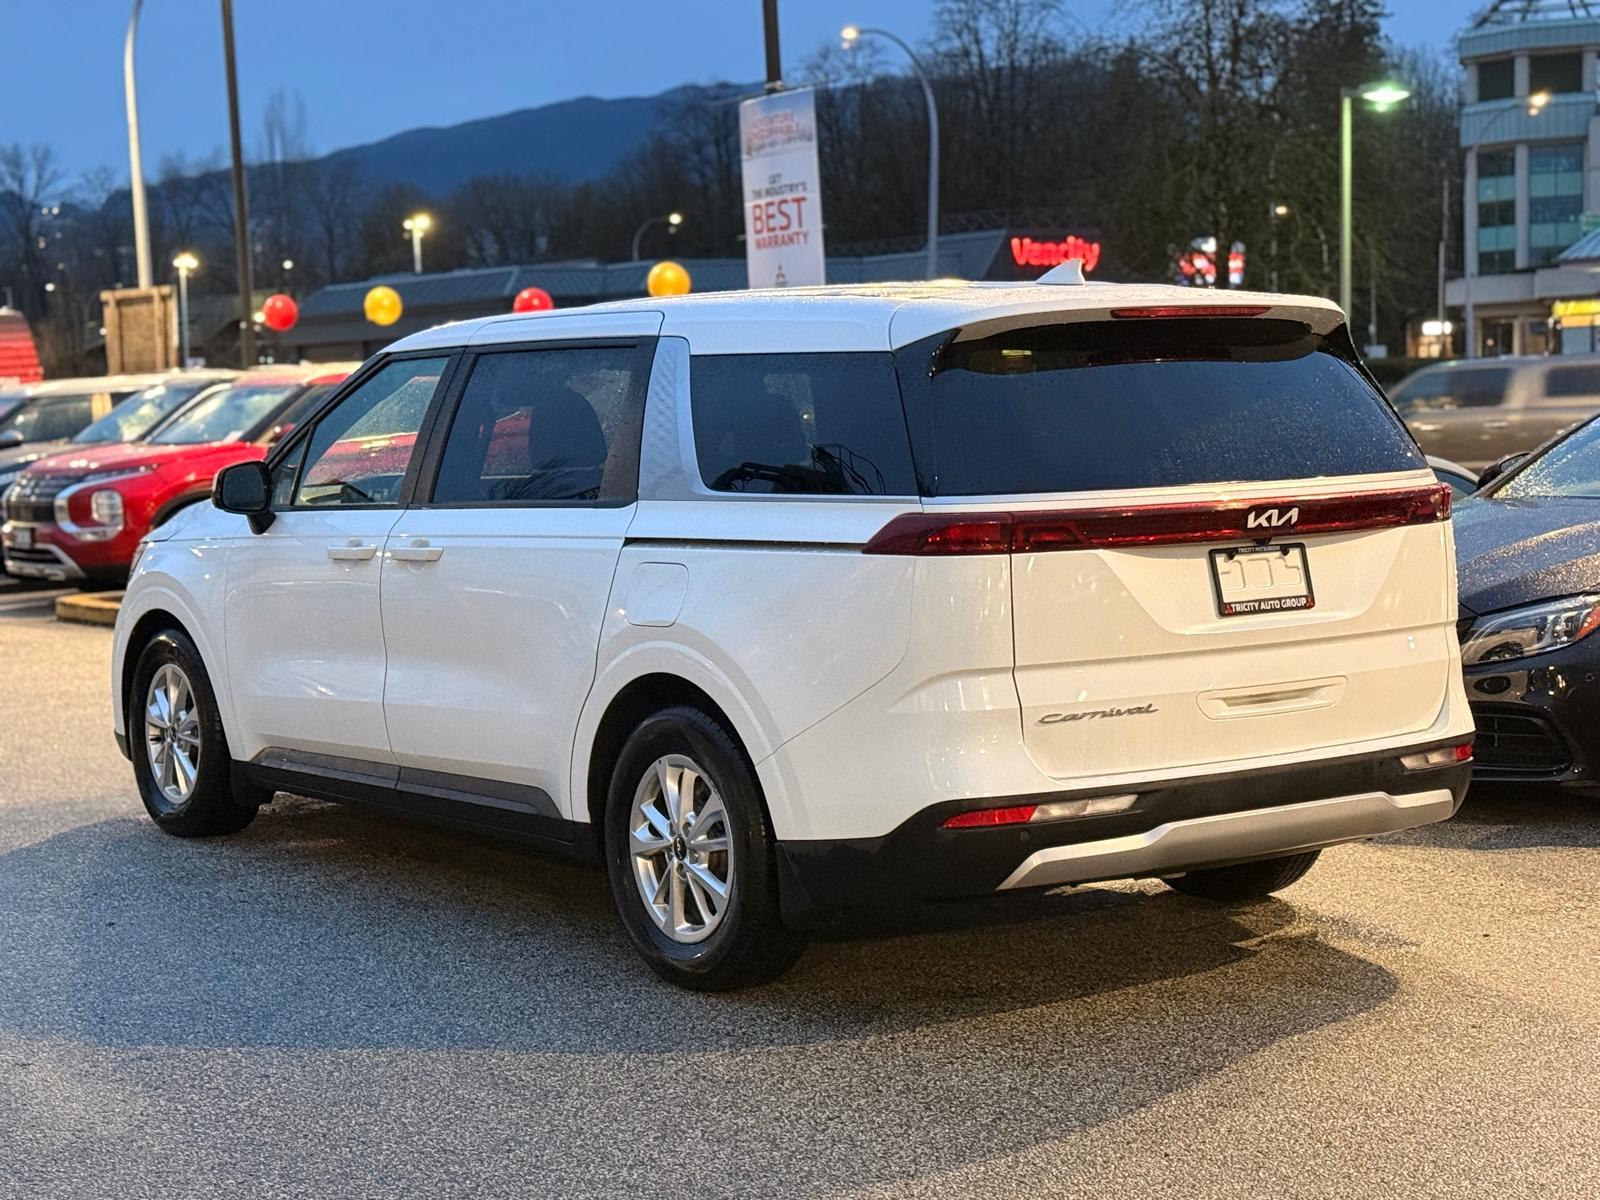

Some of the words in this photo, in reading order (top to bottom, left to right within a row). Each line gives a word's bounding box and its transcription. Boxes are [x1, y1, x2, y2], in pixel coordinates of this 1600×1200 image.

[752, 196, 807, 234] BEST
[755, 230, 809, 250] WARRANTY
[1011, 235, 1100, 271] Vancity
[1247, 507, 1299, 529] KIA
[1230, 602, 1259, 613] TRICITY
[1260, 600, 1281, 611] AUTO
[1281, 597, 1307, 609] GROUP
[1037, 703, 1159, 725] Carnival
